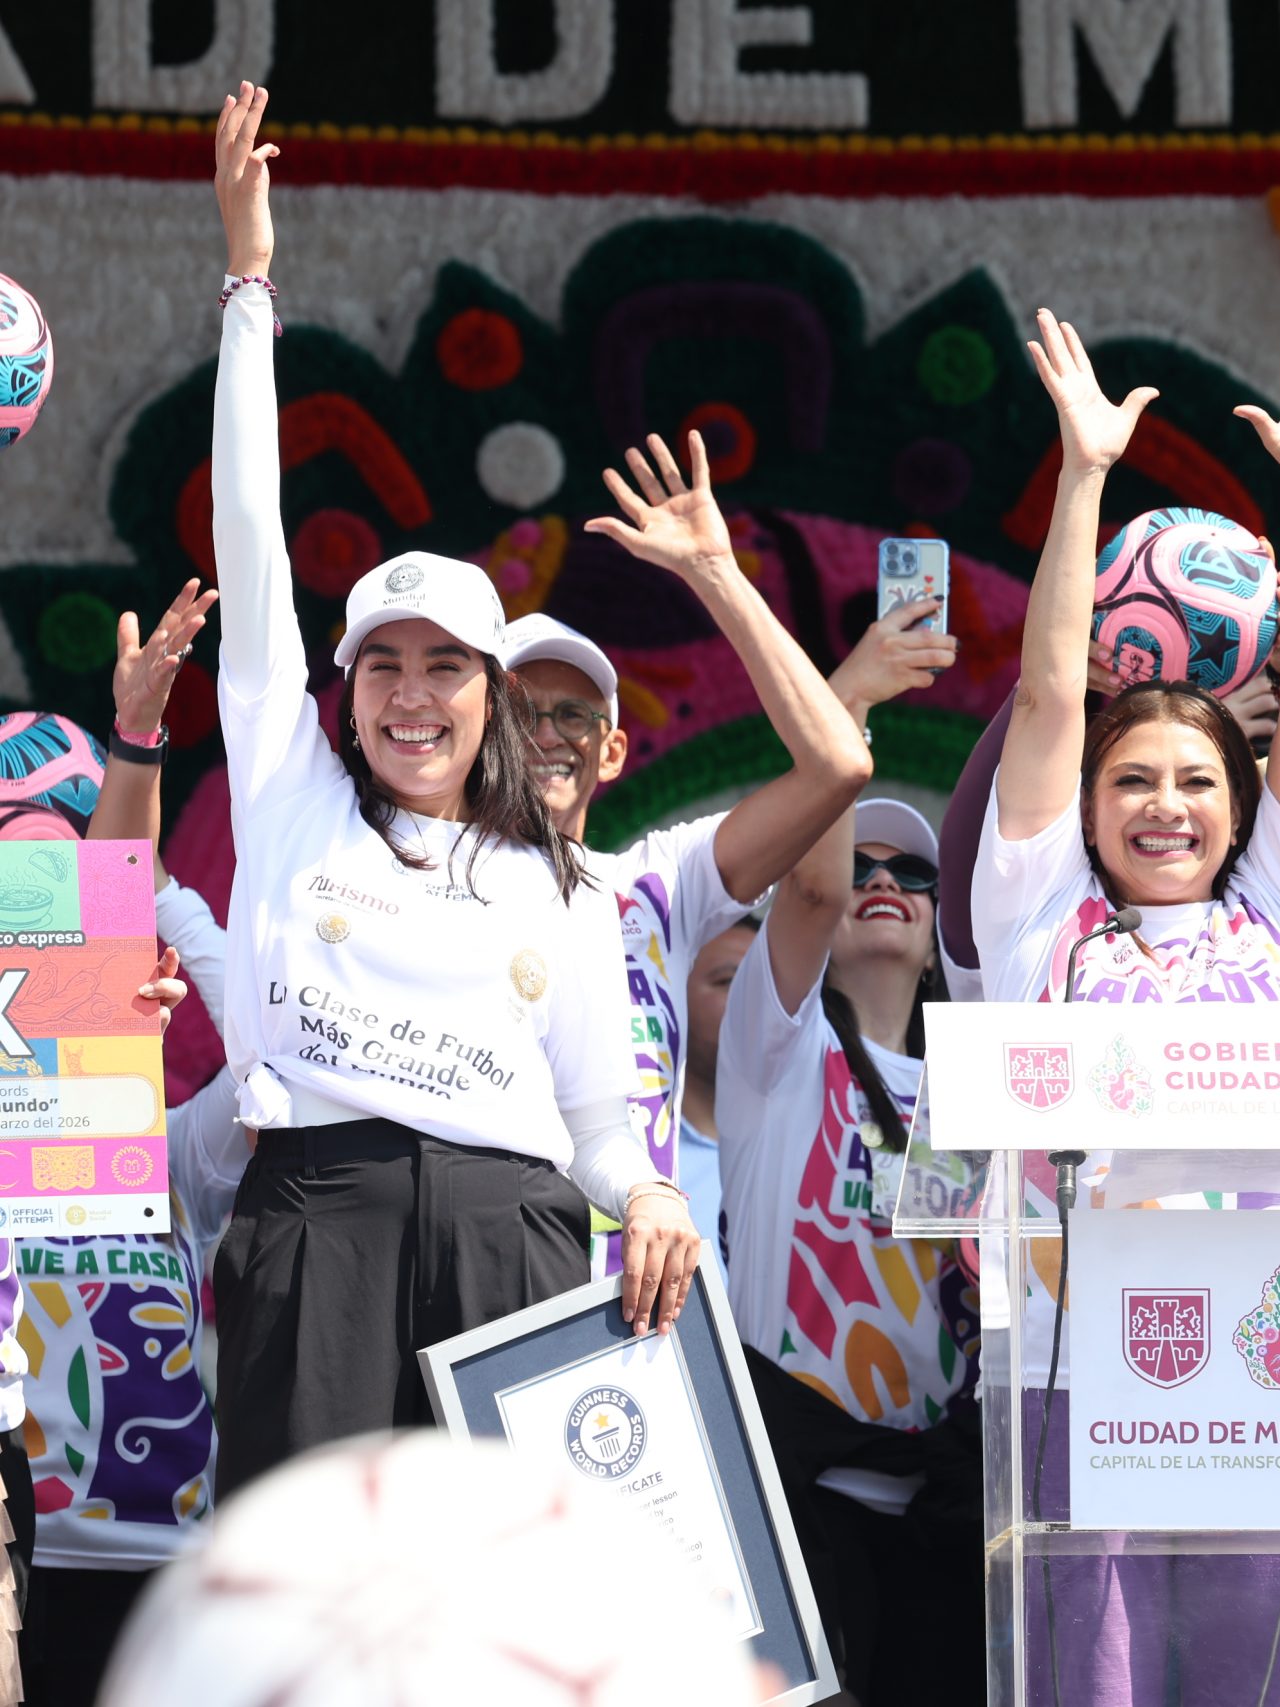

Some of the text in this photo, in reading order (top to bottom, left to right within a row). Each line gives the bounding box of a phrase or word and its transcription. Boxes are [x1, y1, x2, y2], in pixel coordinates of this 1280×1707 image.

[0, 0, 273, 112] D
[308, 875, 400, 915] Turismo
[18, 930, 83, 948] expresa
[298, 985, 379, 1029] Clase
[390, 1020, 426, 1046] de
[435, 1033, 514, 1091] Futbol
[300, 1015, 352, 1050] Más
[361, 1040, 470, 1092] Grande
[1167, 1100, 1237, 1114] CAPITAL
[1244, 1101, 1266, 1114] DE
[34, 1116, 53, 1128] del
[57, 1115, 90, 1128] 2026
[12, 1208, 53, 1216] OFFICIAL
[13, 1216, 54, 1224] ATTEMPT
[75, 1249, 99, 1275] A
[107, 1250, 184, 1284] CASA
[570, 1390, 628, 1428] GUINNESS
[1089, 1421, 1199, 1444] CIUDAD
[1208, 1421, 1246, 1444] DE
[569, 1414, 643, 1477] WORLD RECORDS
[1089, 1455, 1156, 1469] CAPITAL
[1160, 1456, 1182, 1469] DE
[1187, 1456, 1206, 1469] LA
[652, 1491, 678, 1506] lesson
